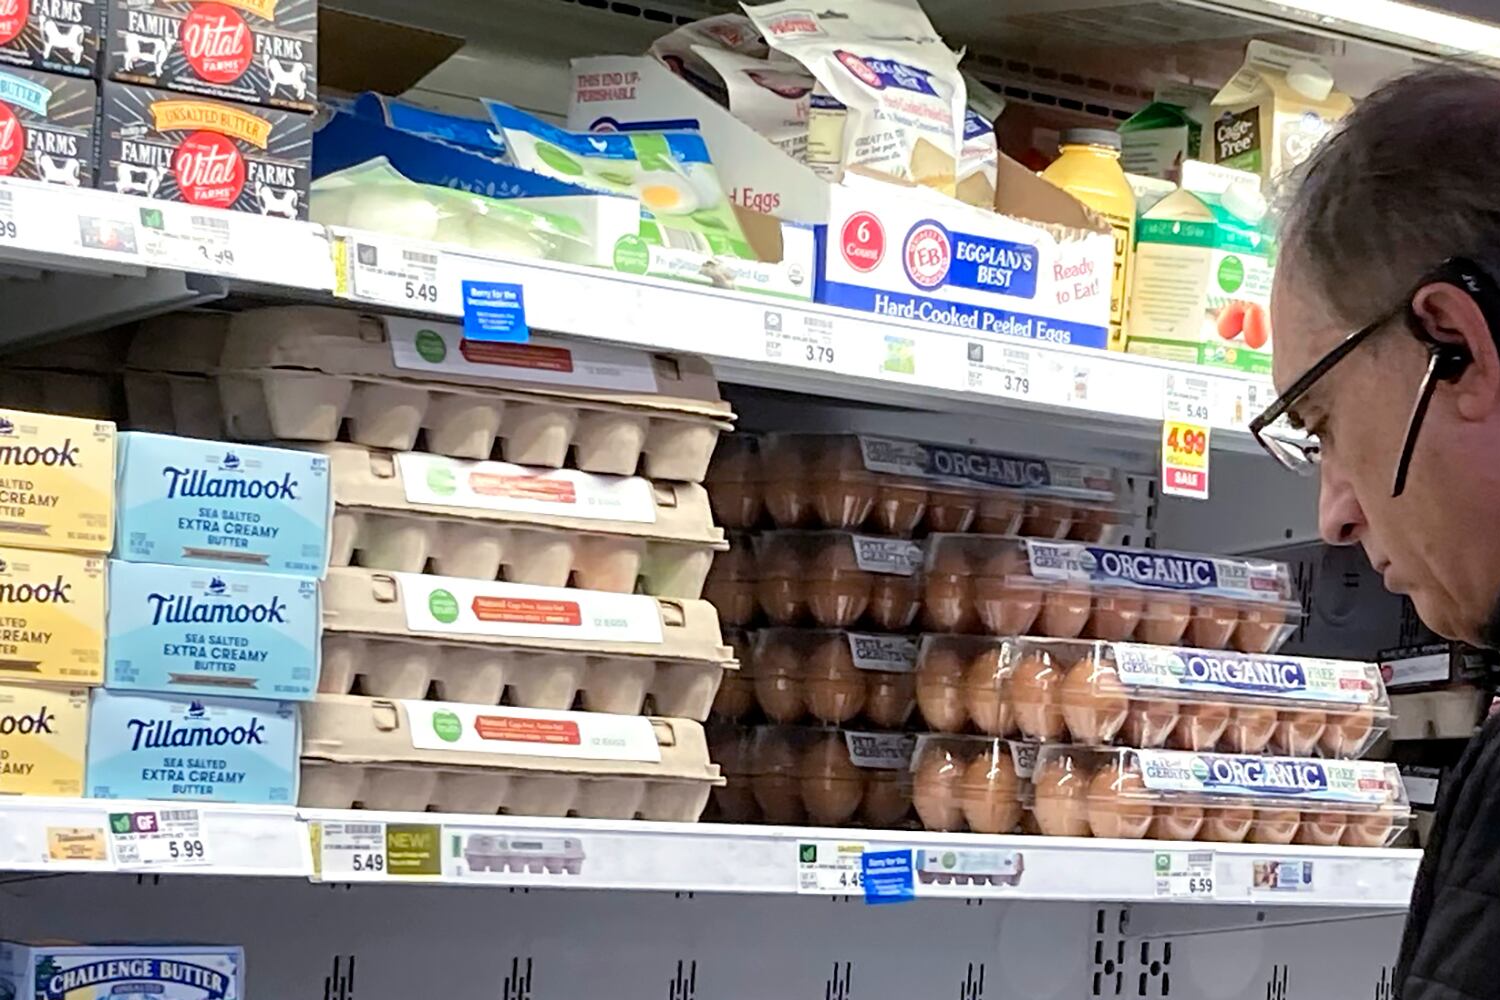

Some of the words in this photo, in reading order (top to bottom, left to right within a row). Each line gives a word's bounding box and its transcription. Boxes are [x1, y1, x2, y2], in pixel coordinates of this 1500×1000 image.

[32, 0, 82, 23] FARMS
[128, 11, 181, 38] FAMILY
[185, 18, 244, 58] Vital
[256, 34, 304, 60] FARMS
[203, 58, 239, 72] FARMS
[602, 72, 622, 86] END
[1, 80, 42, 106] BUTTER
[165, 109, 219, 126] UNSALTED
[220, 112, 261, 139] BUTTER
[27, 136, 77, 156] FARMS
[121, 140, 174, 168] FAMILY
[1221, 135, 1251, 159] Free
[177, 144, 236, 187] Vital
[248, 162, 295, 188] FARMS
[194, 187, 232, 201] FARMS
[743, 187, 781, 214] Eggs
[856, 221, 870, 243] 6
[846, 243, 878, 261] Count
[916, 246, 941, 268] EB
[976, 267, 1012, 288] BEST
[1053, 260, 1096, 283] Ready
[405, 282, 438, 303] 5.49
[1056, 290, 1069, 304] to
[1074, 282, 1100, 301] Eat!
[873, 293, 979, 330] Hard-Cooked
[982, 312, 1033, 339] Peeled
[1035, 320, 1072, 345] Eggs
[806, 346, 834, 364] 3.79
[1004, 375, 1031, 394] 3.79
[1186, 404, 1208, 420] 5.49
[1167, 427, 1206, 456] 4.99
[934, 450, 1045, 486] ORGANIC
[1174, 471, 1198, 486] SALE
[163, 466, 300, 501] Tillamook
[199, 507, 221, 519] SEA
[224, 510, 261, 523] SALTED
[178, 518, 222, 535] EXTRA
[225, 521, 280, 539] CREAMY
[207, 536, 249, 549] BUTTER
[1101, 552, 1212, 586] ORGANIC
[1218, 565, 1247, 577] FREE
[147, 592, 287, 626] Tillamook
[185, 633, 206, 645] SEA
[209, 635, 249, 648] SALTED
[163, 644, 207, 659] EXTRA
[211, 646, 269, 663] CREAMY
[194, 661, 237, 673] BUTTER
[1188, 655, 1300, 689] ORGANIC
[1308, 667, 1336, 680] FREE
[127, 717, 266, 751] Tillamook
[163, 757, 184, 769] SEA
[187, 758, 227, 770] SALTED
[1212, 759, 1321, 788] ORGANIC
[1328, 767, 1355, 779] FREE
[142, 768, 186, 783] EXTRA
[190, 771, 247, 785] CREAMY
[172, 785, 214, 796] BUTTER
[136, 813, 157, 831] GF
[169, 839, 204, 859] 5.99
[353, 852, 384, 872] 5.49
[1189, 878, 1213, 893] 6.59
[50, 960, 153, 995] CHALLENGE
[160, 960, 223, 993] BUTTER
